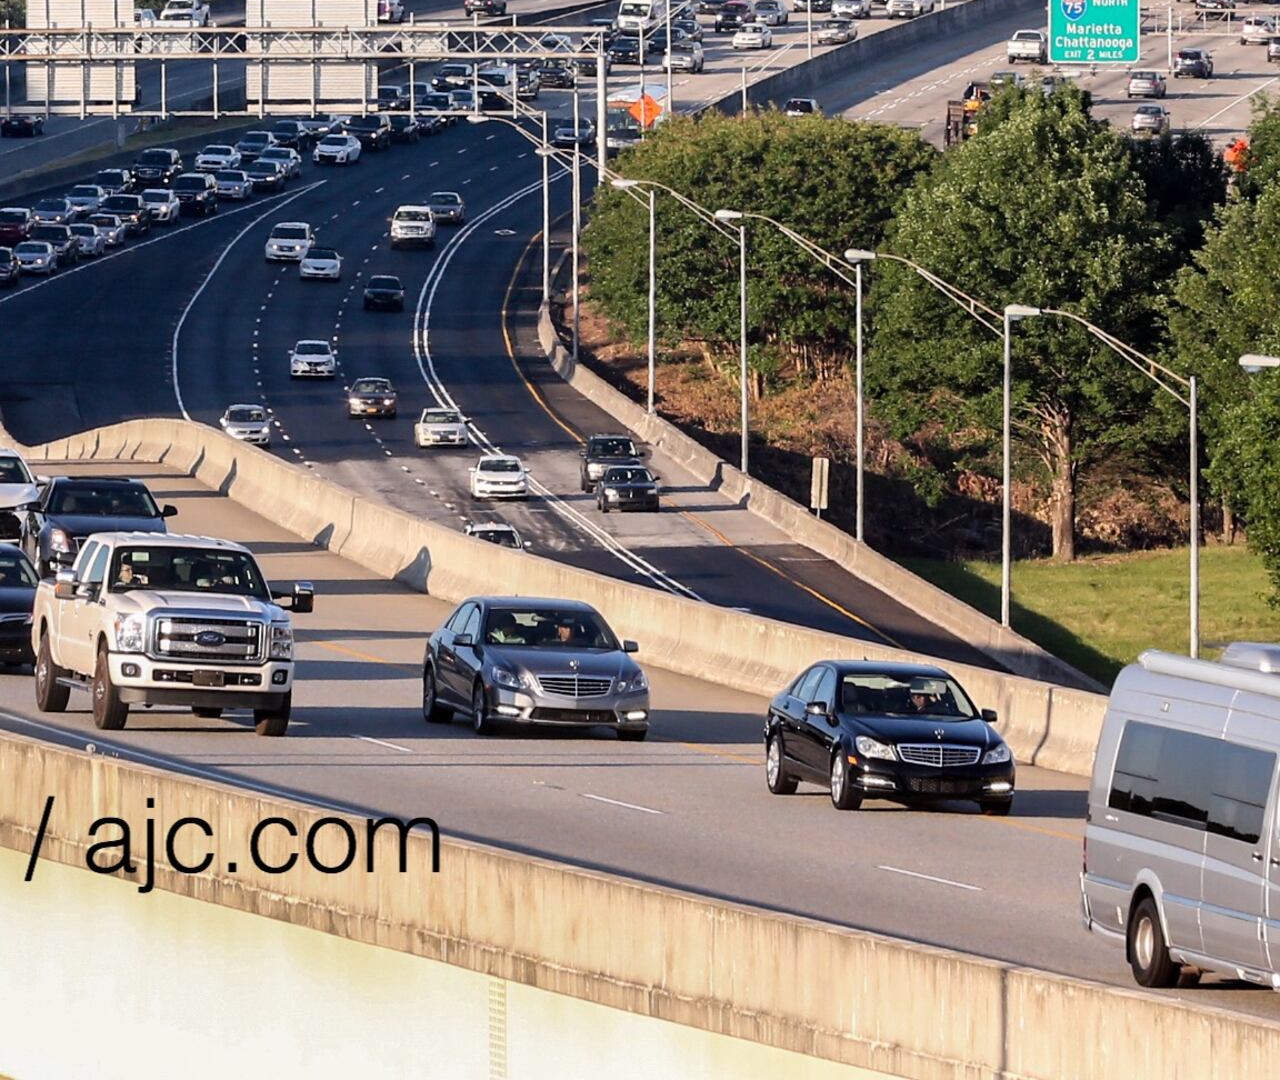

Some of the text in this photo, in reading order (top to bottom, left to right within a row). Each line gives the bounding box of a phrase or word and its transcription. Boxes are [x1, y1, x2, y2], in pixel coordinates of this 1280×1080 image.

[1065, 1, 1083, 15] 75
[1066, 23, 1123, 35] Marietta
[1055, 36, 1133, 52] Chattanooga
[1064, 49, 1124, 60] EXIT 2 MILES
